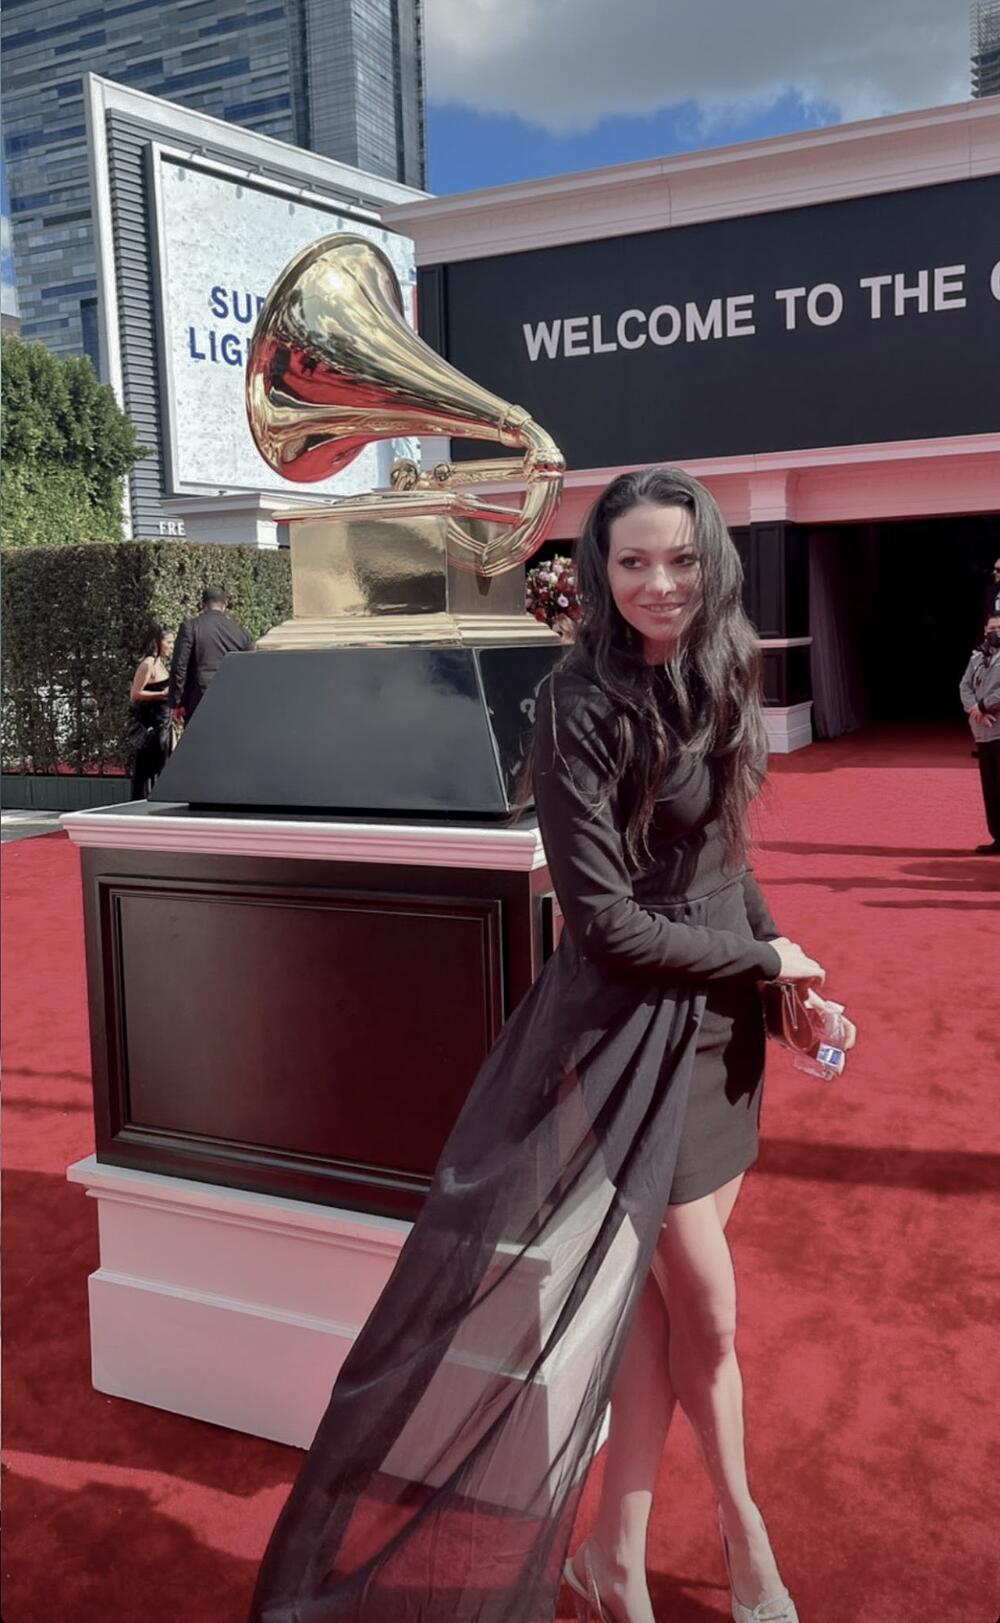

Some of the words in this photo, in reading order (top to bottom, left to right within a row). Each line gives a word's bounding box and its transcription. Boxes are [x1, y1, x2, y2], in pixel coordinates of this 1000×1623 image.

[523, 294, 756, 361] WELCOME
[775, 283, 843, 330] TO
[859, 264, 966, 319] THE
[189, 327, 252, 366] LIG
[159, 521, 186, 536] FRE
